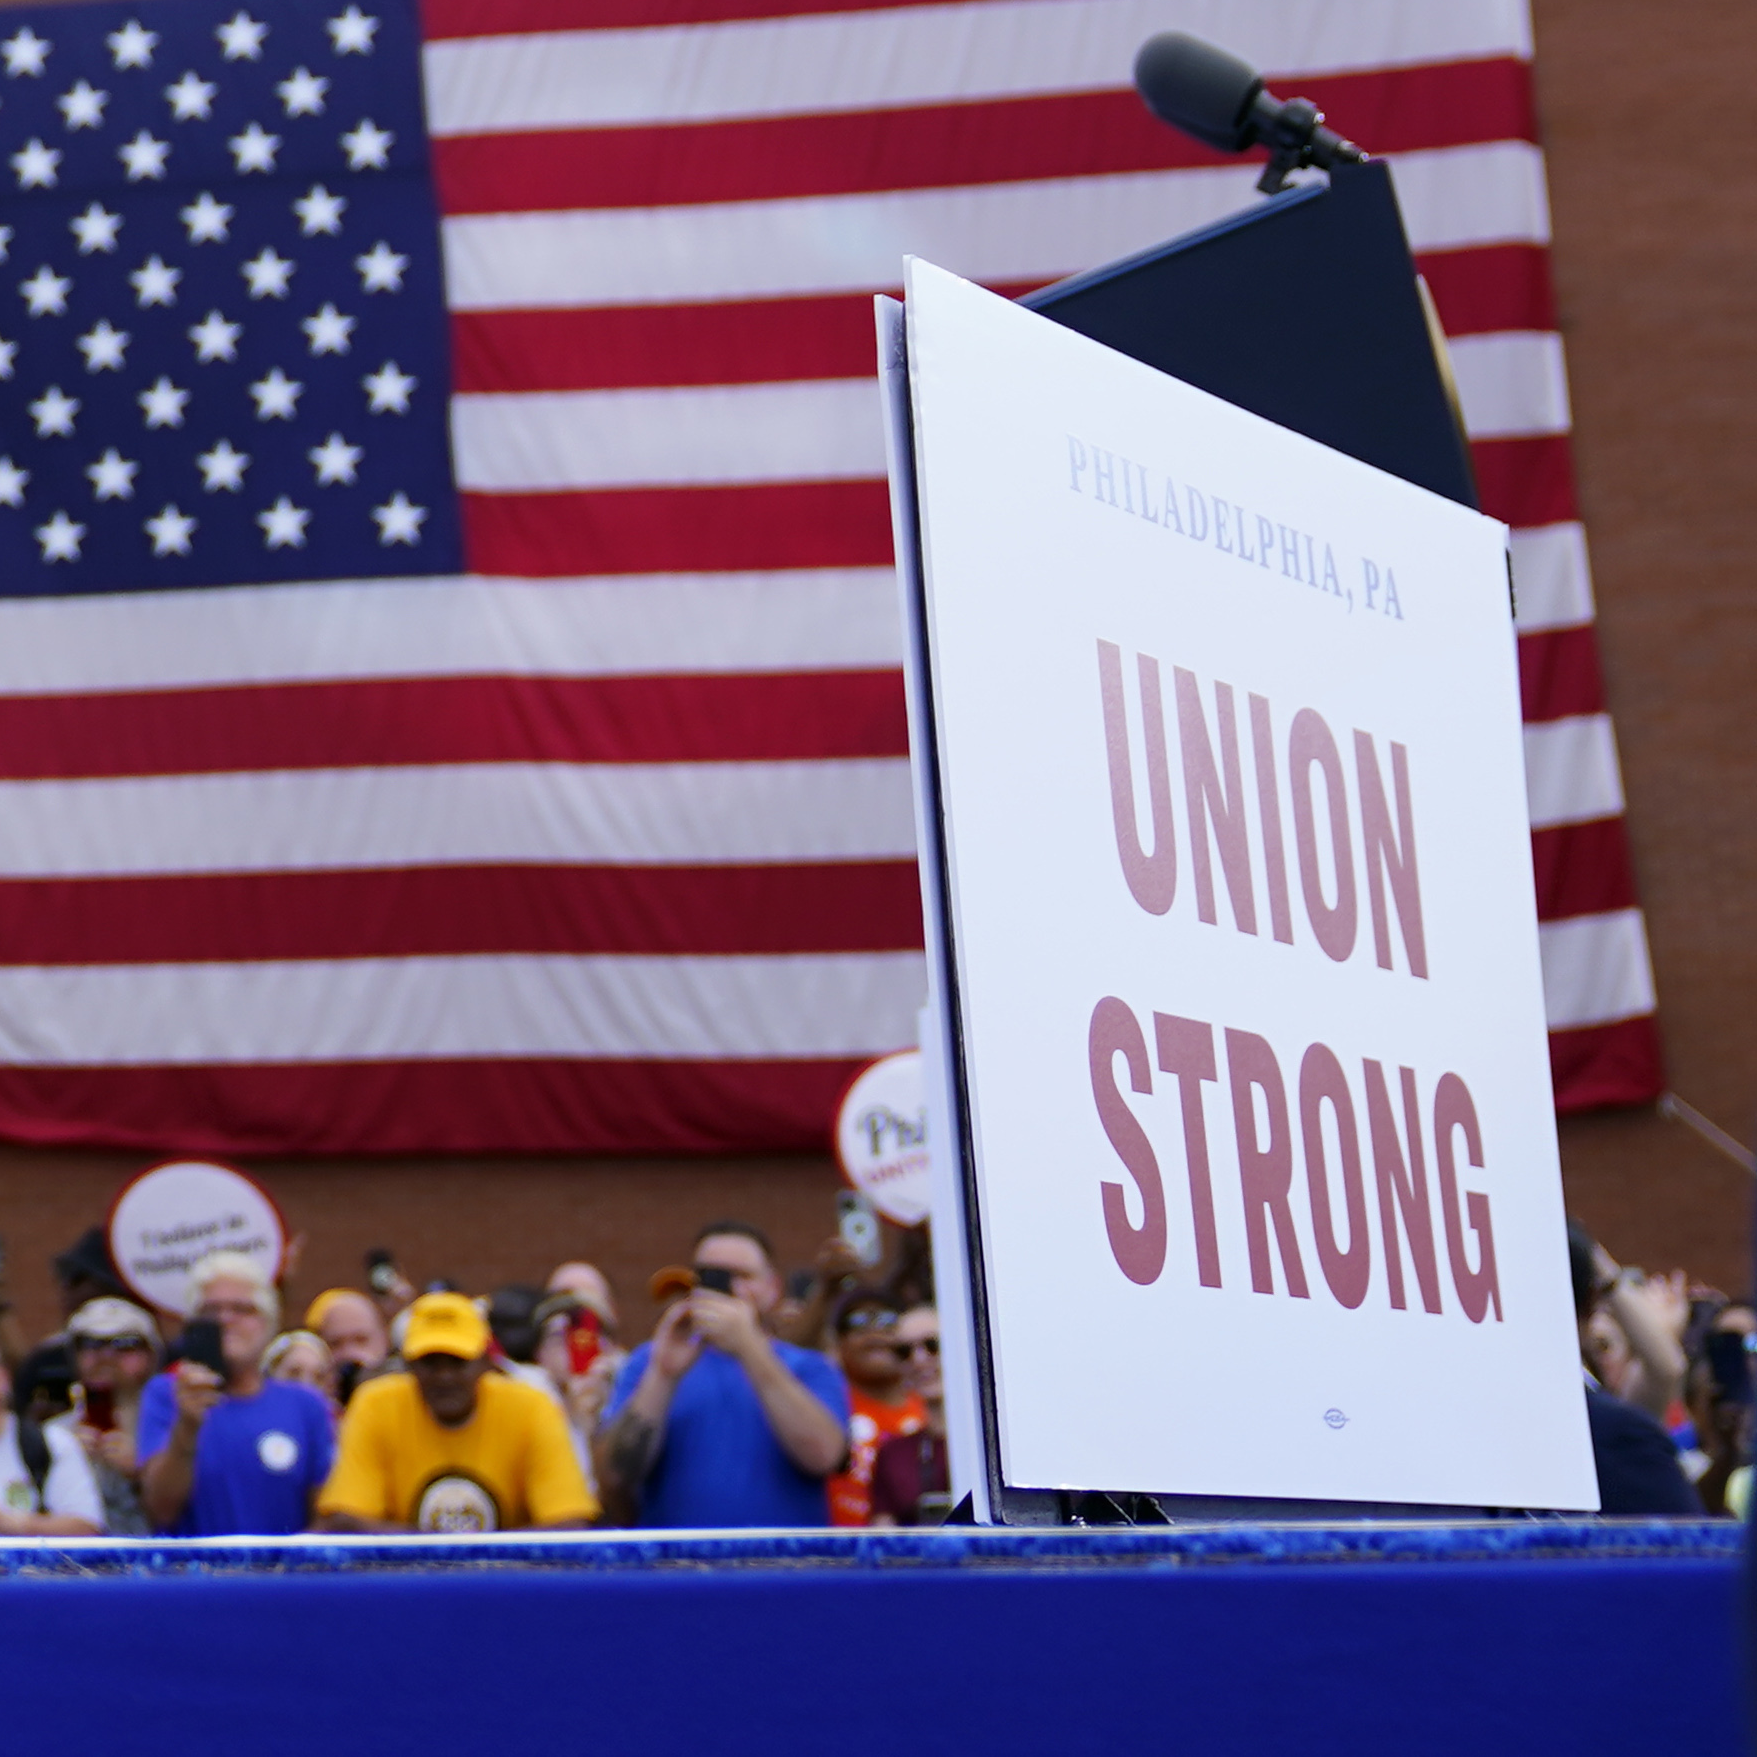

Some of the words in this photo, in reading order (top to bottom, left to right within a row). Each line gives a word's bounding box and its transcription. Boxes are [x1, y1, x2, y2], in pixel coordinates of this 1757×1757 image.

[1066, 433, 1354, 613] PHILADELPHIA,
[1362, 556, 1405, 621] PA
[1096, 637, 1429, 980] UNION
[1088, 995, 1504, 1324] STRONG
